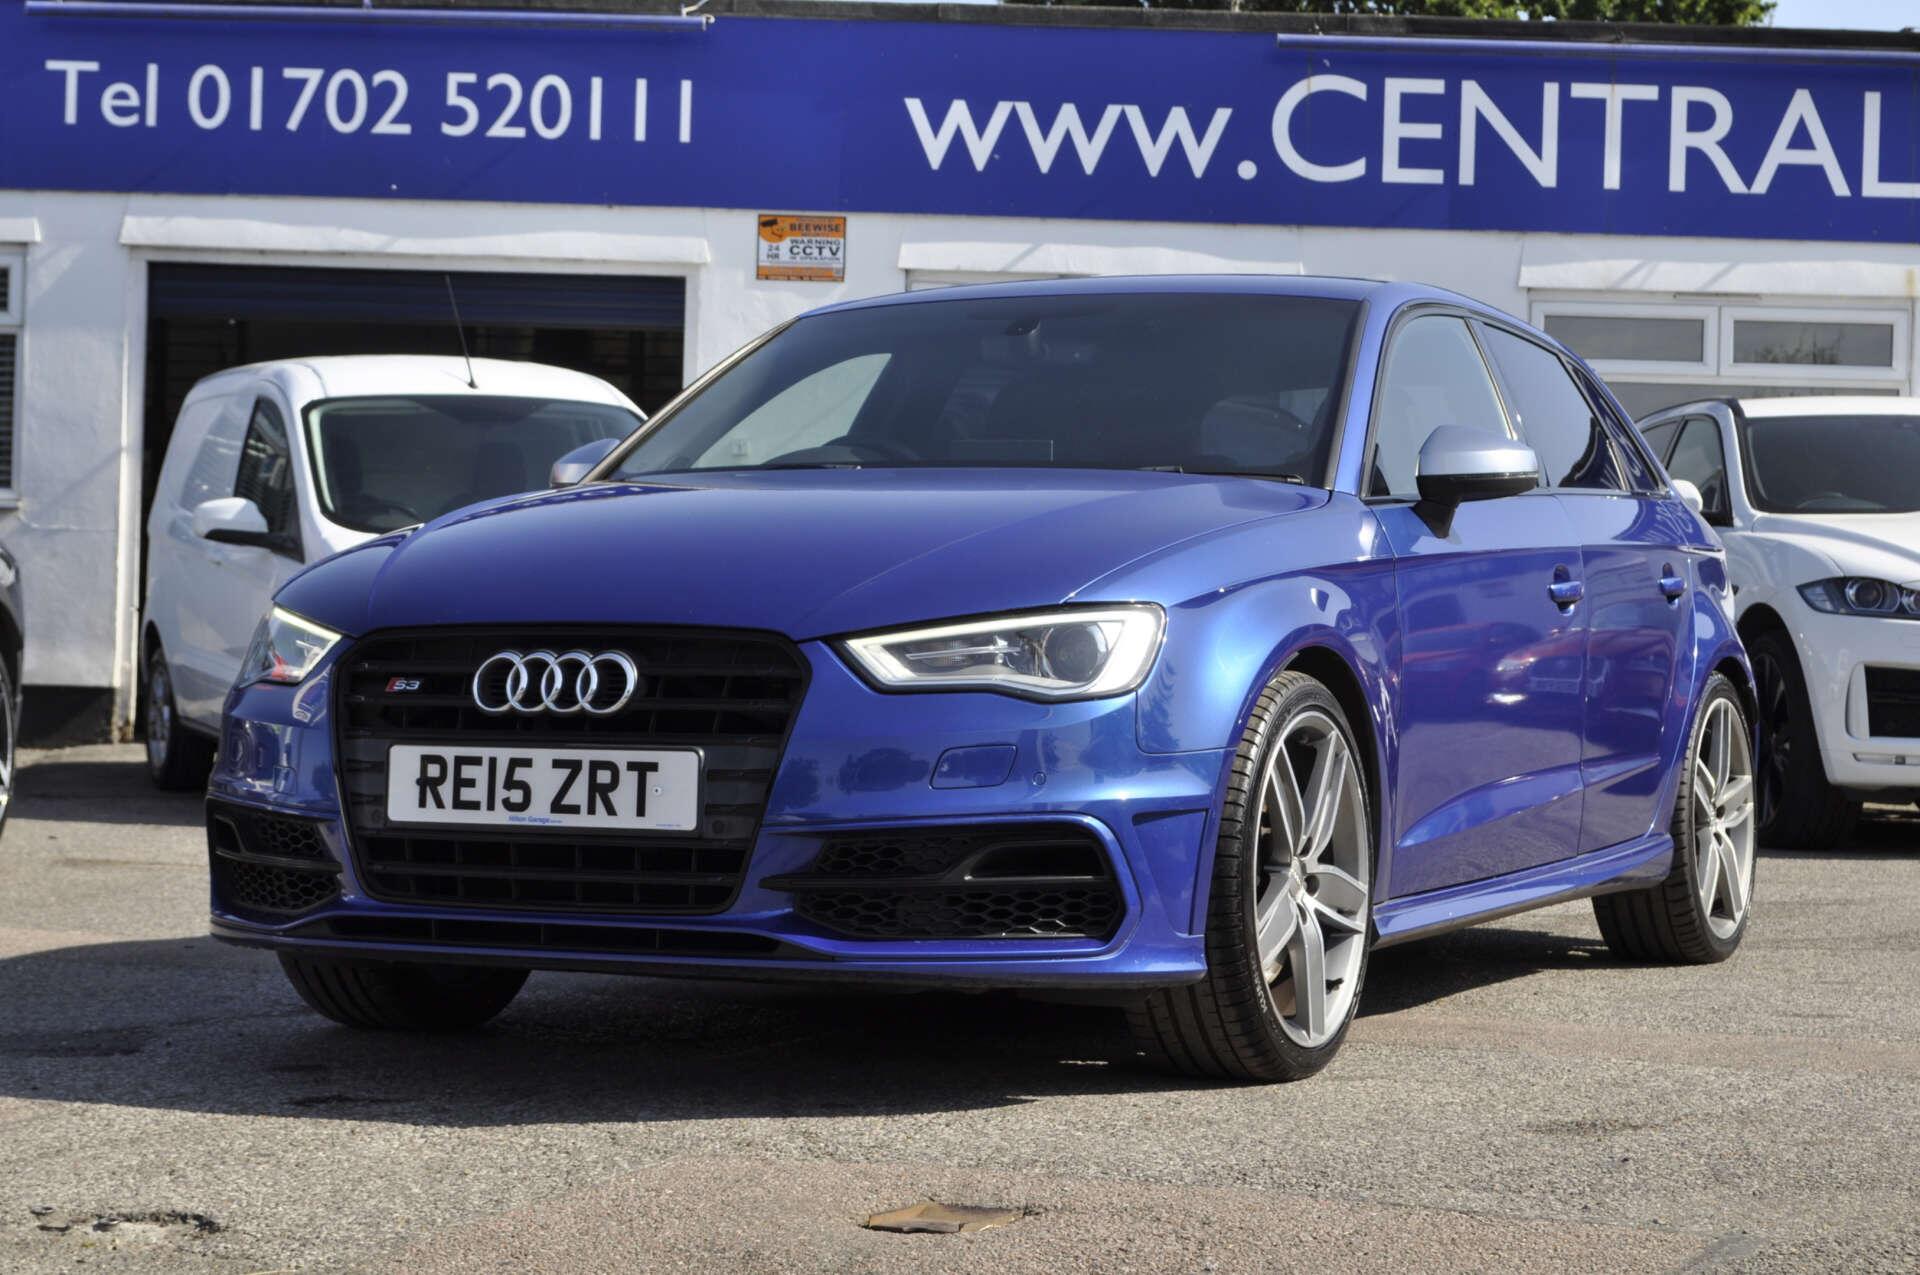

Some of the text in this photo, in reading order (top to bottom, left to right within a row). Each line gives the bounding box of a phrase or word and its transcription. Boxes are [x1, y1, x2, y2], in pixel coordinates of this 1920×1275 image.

[45, 60, 693, 144] Tel 01702 520111
[903, 73, 1920, 198] www.CENTRAL
[789, 245, 840, 256] CCTV
[393, 680, 420, 690] S3
[416, 754, 659, 818] RE15 ZRT
